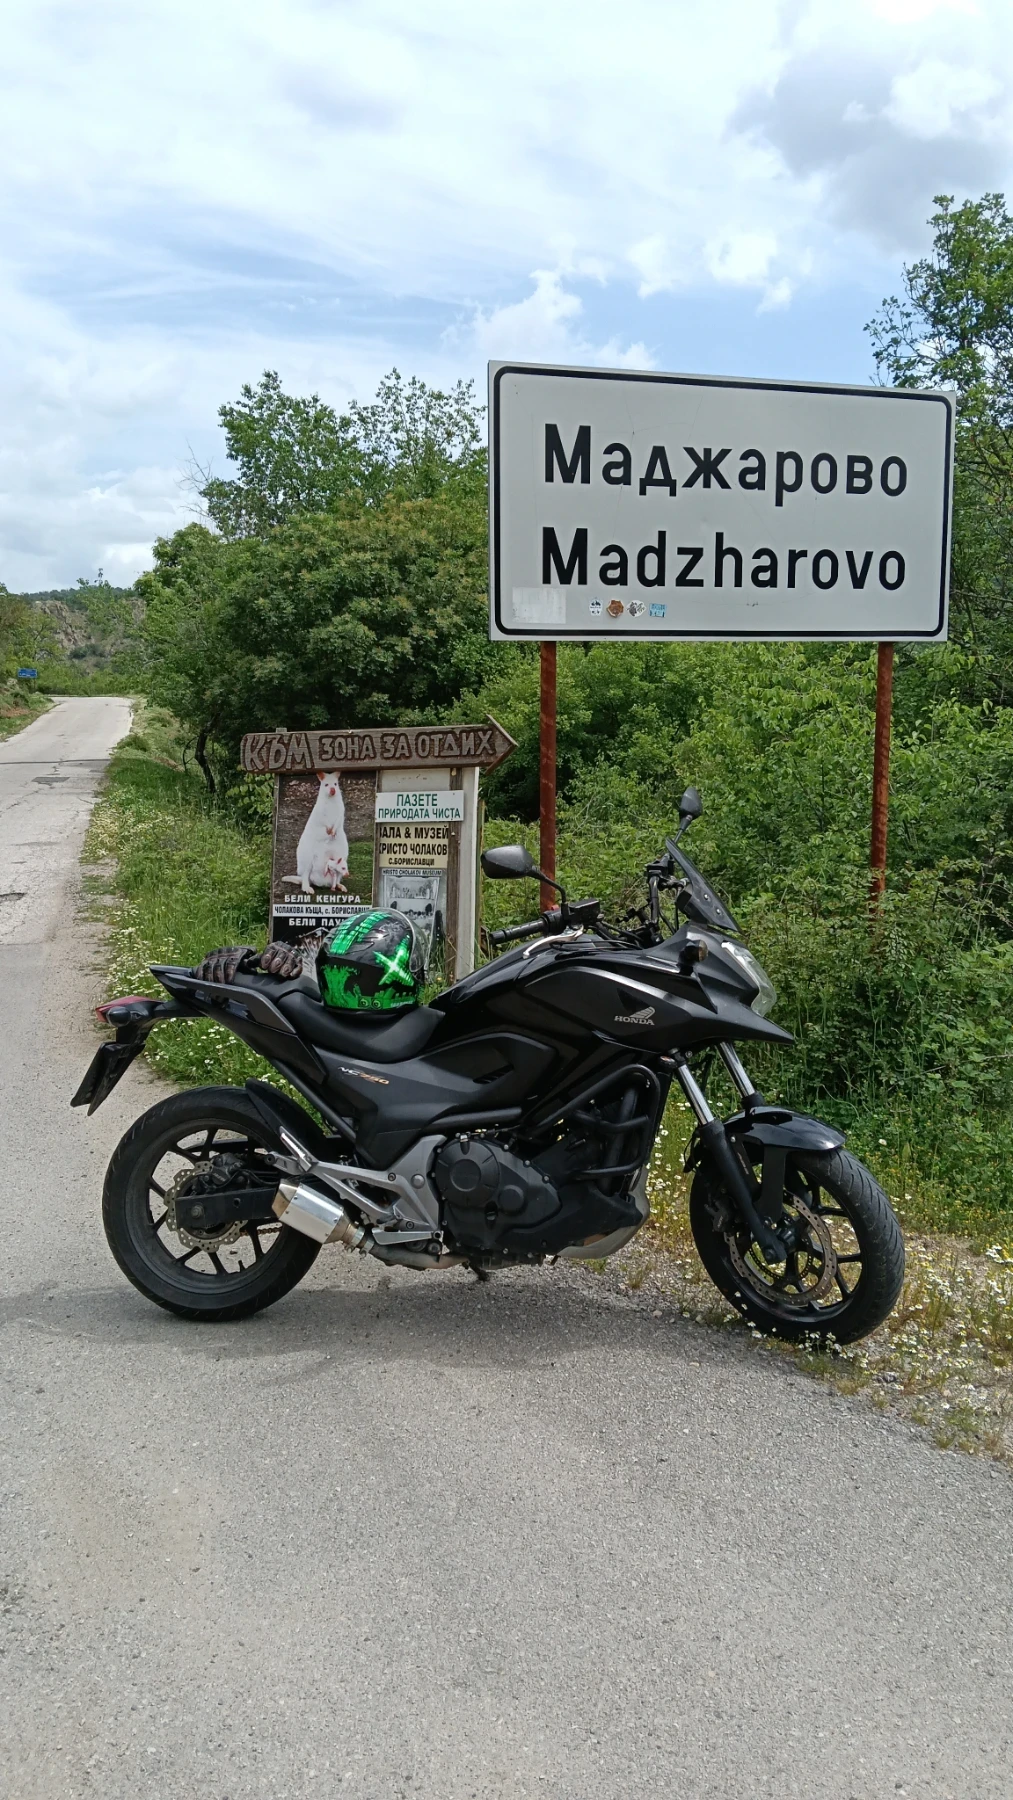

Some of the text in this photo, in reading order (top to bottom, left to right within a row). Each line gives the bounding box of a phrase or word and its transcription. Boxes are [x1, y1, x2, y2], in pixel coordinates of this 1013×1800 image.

[544, 423, 908, 508] Маджарово
[542, 526, 906, 591] Madzharovo
[244, 730, 494, 771] КЪМ ЗОНА ЗА ОТДИХ
[396, 793, 438, 807] ПАЗЕТЕ
[378, 807, 461, 820] ПРИРОДАТА ЧИСТА
[404, 826, 411, 838] &
[414, 824, 449, 839] МУЗЕЙ
[410, 843, 448, 856] ЧОЛАКОВ
[284, 895, 361, 904] БЕЛИ КЕНГУРА
[288, 918, 316, 927] БЕЛИ
[614, 1015, 655, 1026] HONDA
